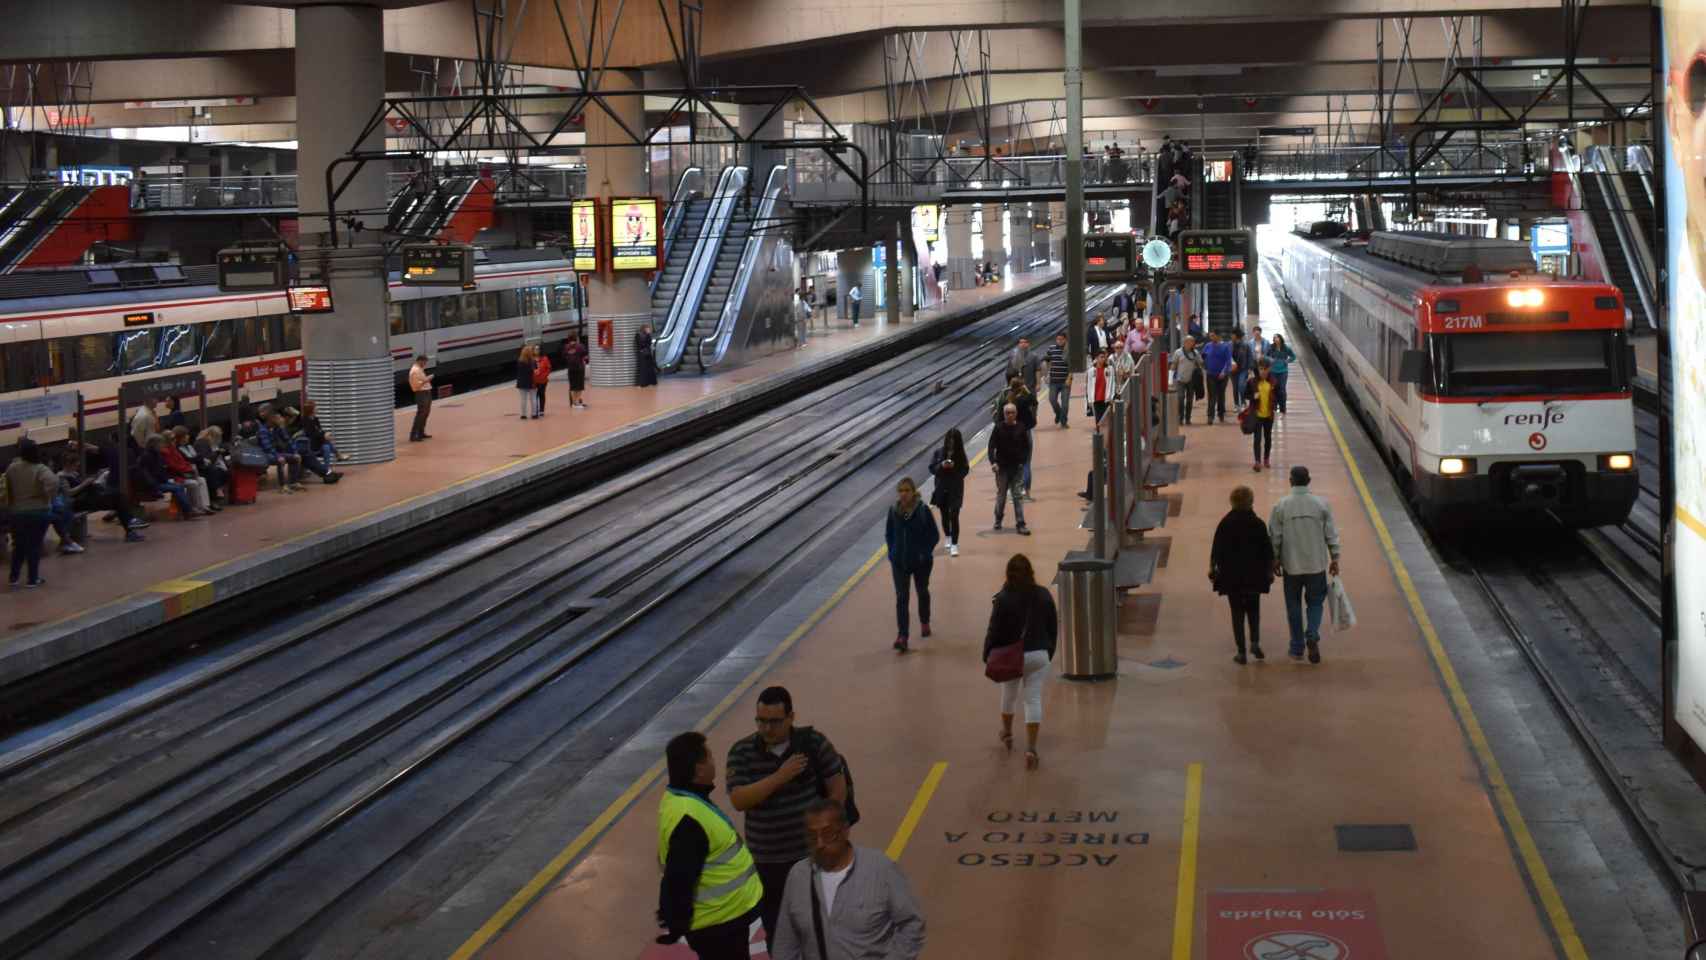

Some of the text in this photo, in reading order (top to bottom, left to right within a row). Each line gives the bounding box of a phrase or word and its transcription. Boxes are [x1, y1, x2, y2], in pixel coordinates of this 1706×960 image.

[1444, 316, 1482, 329] 217M
[1503, 407, 1565, 430] renfe
[987, 810, 1120, 823] METRO
[944, 831, 1149, 845] DIRECTO A
[958, 853, 1119, 866] ACCESO
[1219, 907, 1366, 920] Sólo bajada
